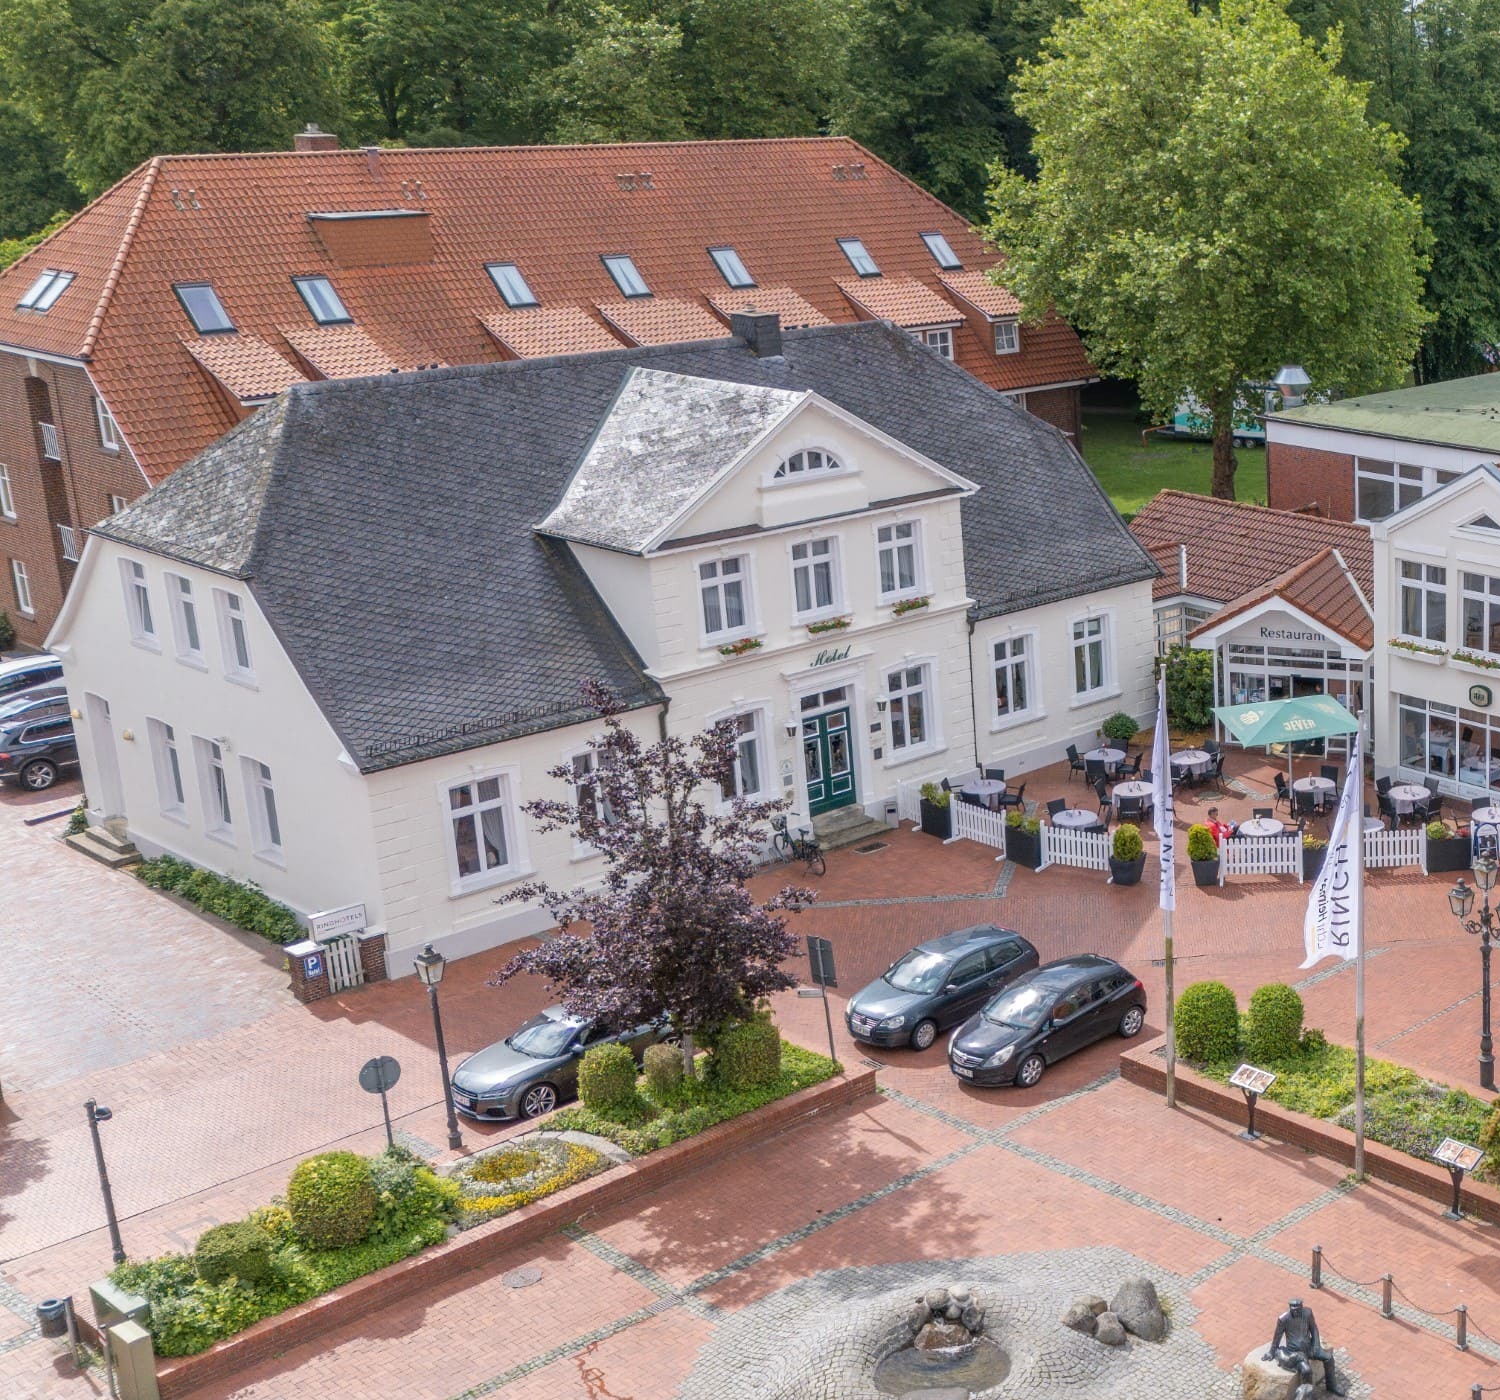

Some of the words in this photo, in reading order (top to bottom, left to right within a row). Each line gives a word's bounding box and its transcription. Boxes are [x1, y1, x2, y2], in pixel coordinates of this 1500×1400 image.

[810, 644, 851, 668] Hotel
[1283, 719, 1317, 731] JEVER
[308, 956, 317, 969] P
